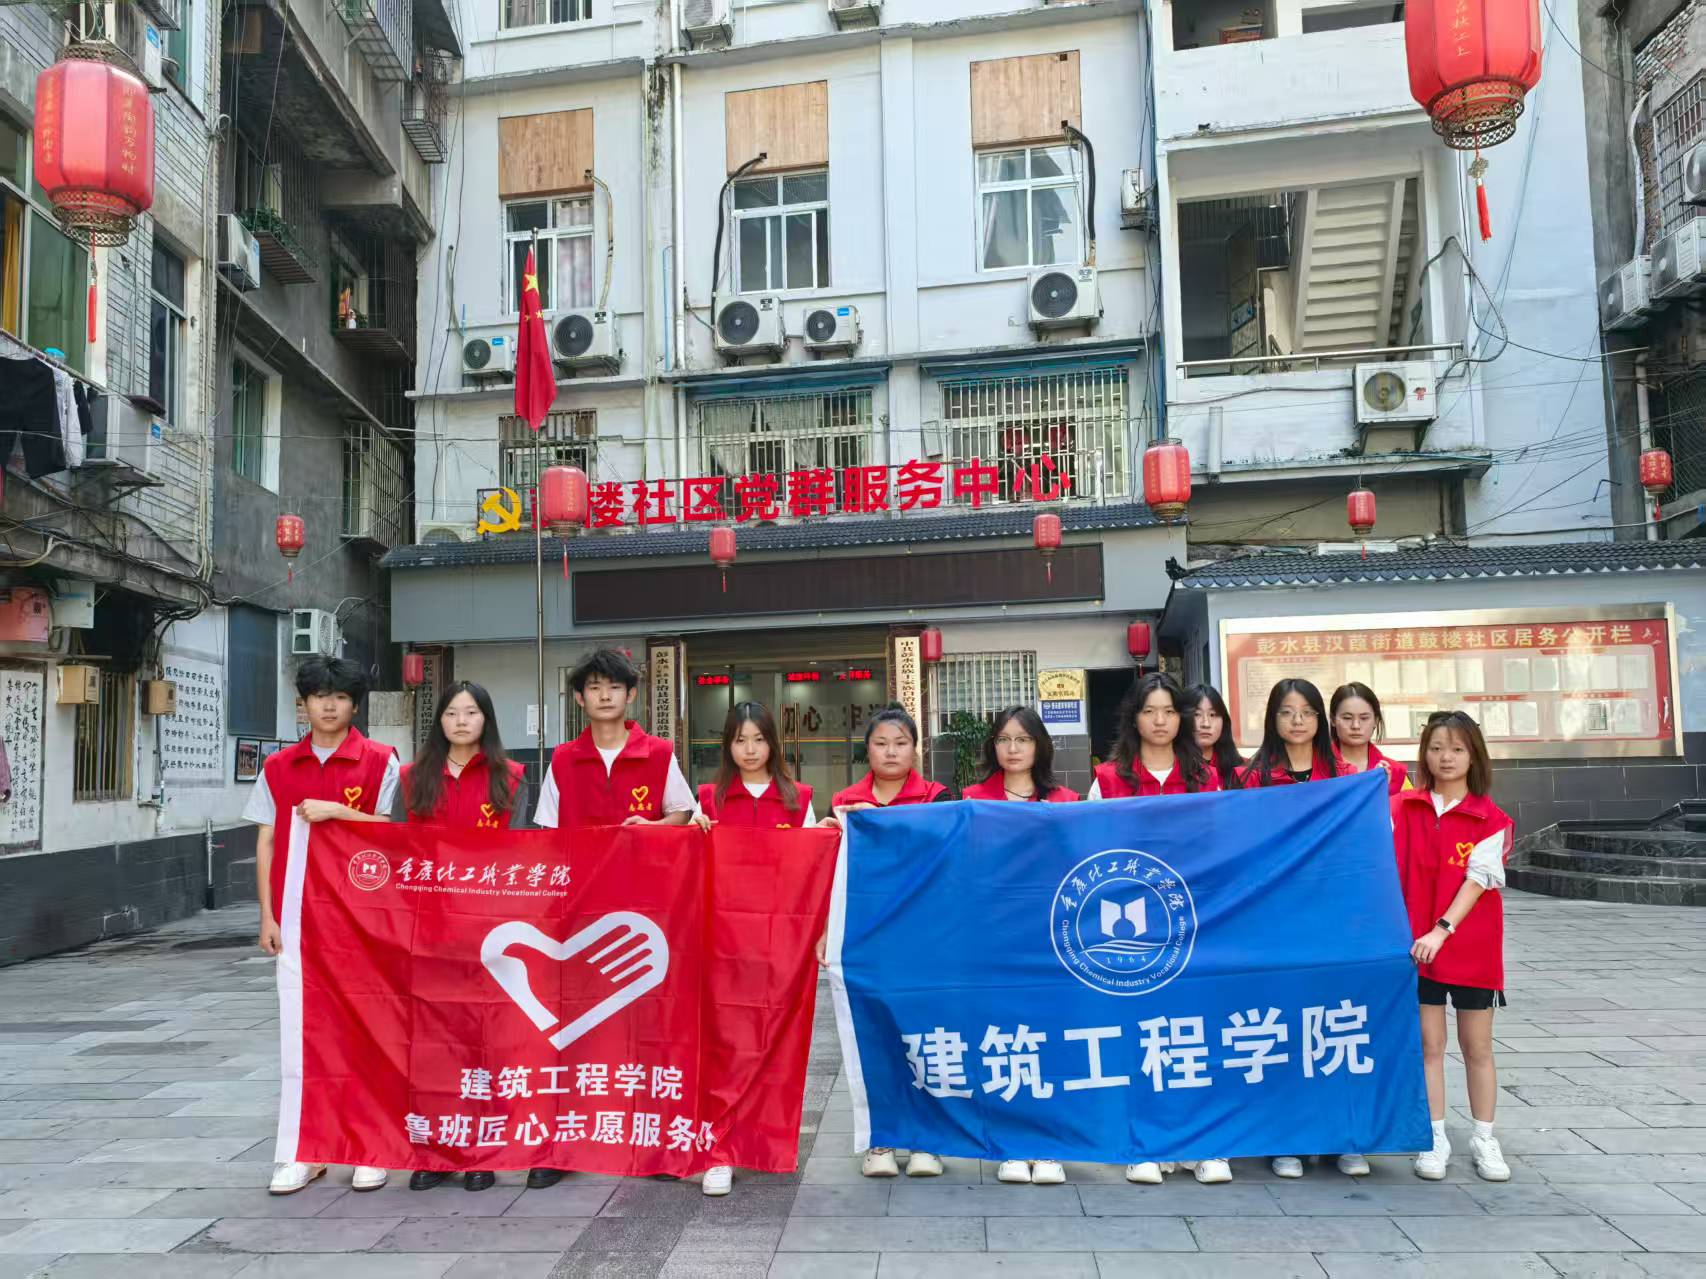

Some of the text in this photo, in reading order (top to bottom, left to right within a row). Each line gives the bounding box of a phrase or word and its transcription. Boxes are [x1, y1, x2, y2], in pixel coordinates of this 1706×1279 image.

[530, 454, 1072, 528] 楼社区党群服务中心
[395, 883, 432, 893] Chongqing
[433, 885, 467, 894] Chemical
[468, 887, 500, 896] Industry
[502, 888, 541, 897] Vocational
[1080, 962, 1115, 986] Chemical
[1115, 977, 1150, 987] Industry
[1150, 946, 1180, 979] Vocational
[1175, 915, 1187, 946] College
[459, 1063, 684, 1101] 建筑工程学院
[902, 999, 1374, 1103] 建筑工程学院
